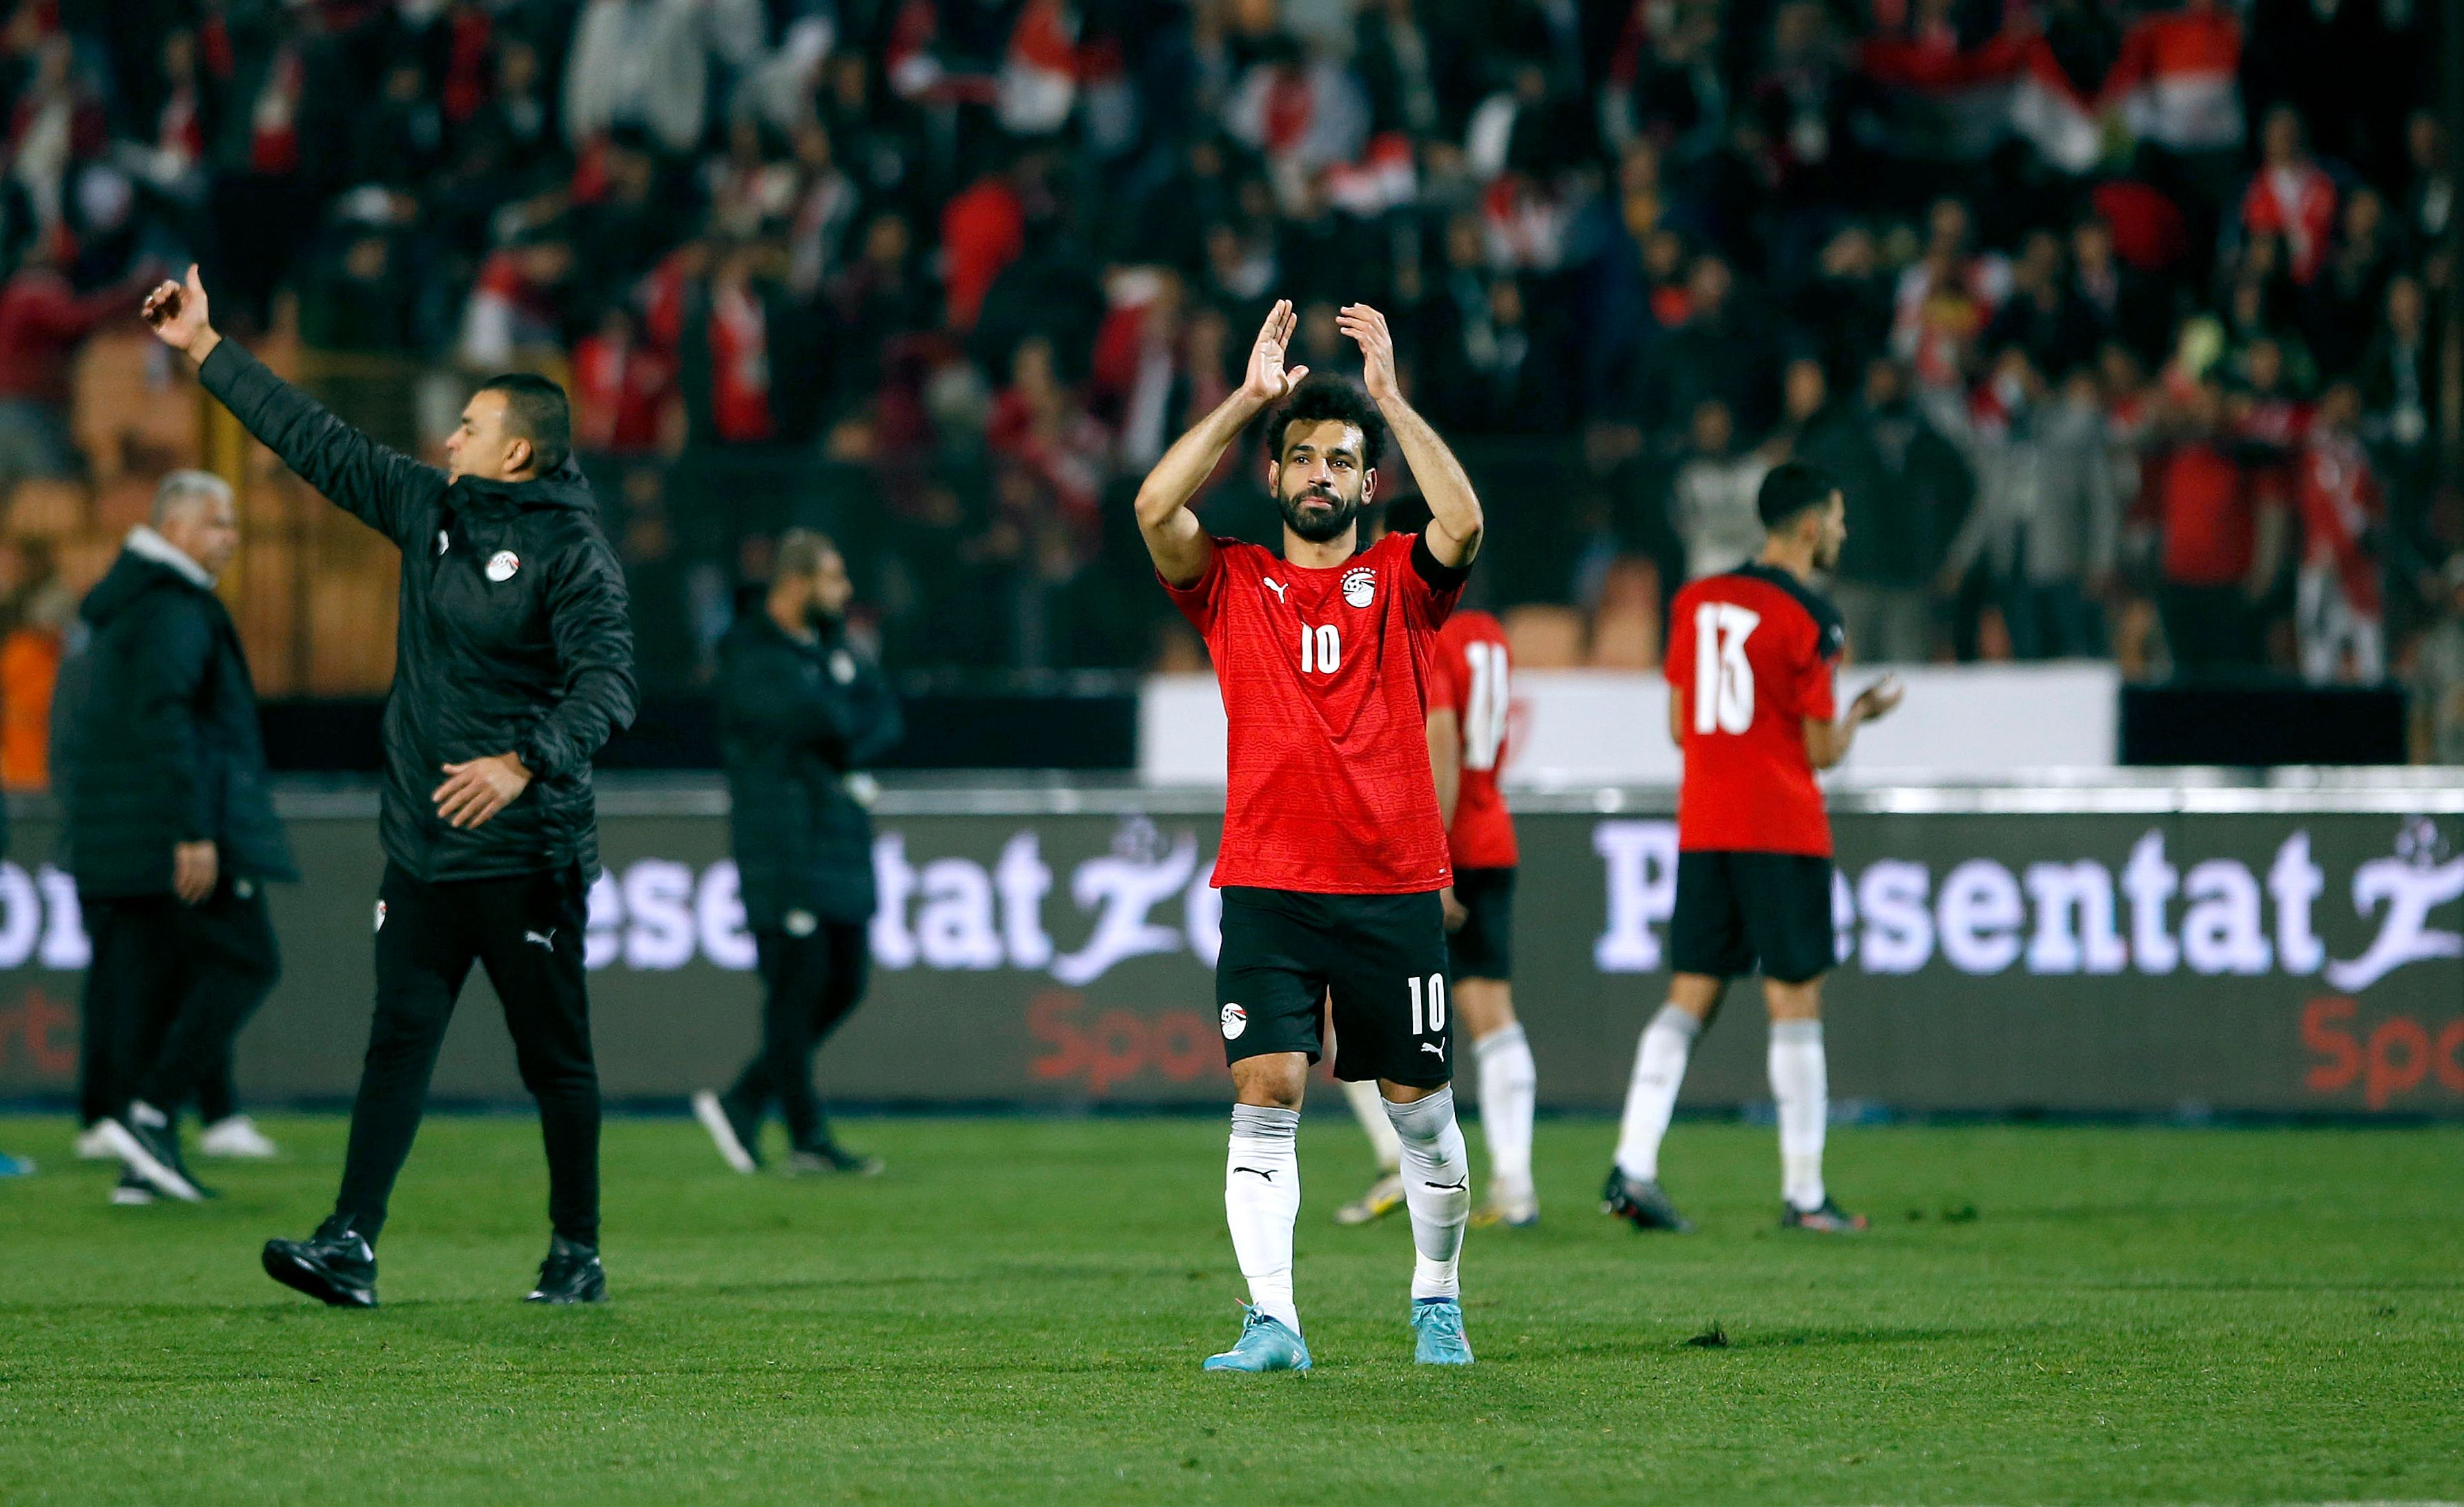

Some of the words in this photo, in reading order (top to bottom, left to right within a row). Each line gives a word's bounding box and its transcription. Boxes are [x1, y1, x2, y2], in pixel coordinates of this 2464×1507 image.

[1300, 621, 1342, 674] 10
[1694, 601, 1761, 735] 13
[1408, 973, 1446, 1035] 10
